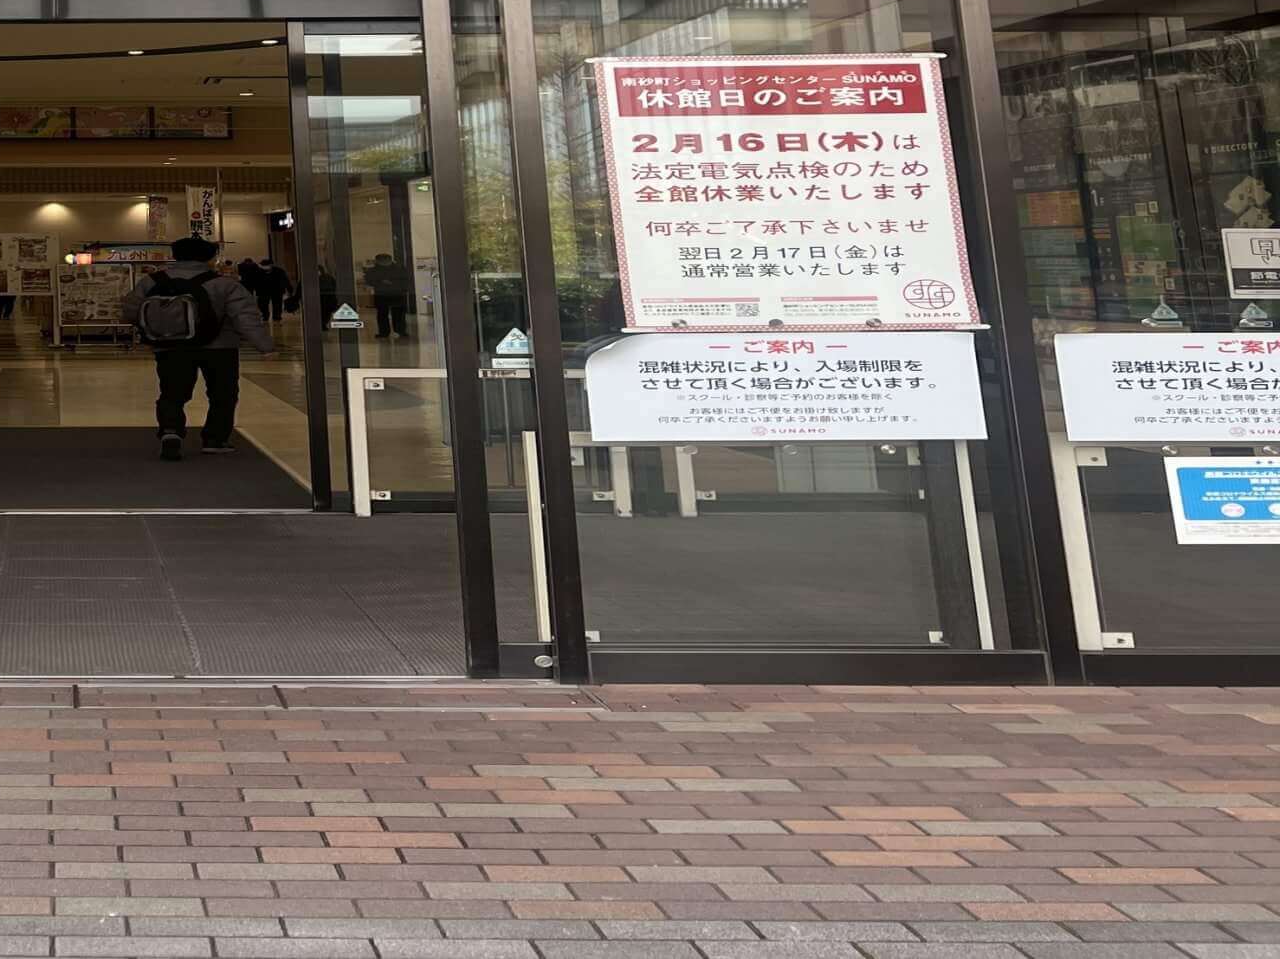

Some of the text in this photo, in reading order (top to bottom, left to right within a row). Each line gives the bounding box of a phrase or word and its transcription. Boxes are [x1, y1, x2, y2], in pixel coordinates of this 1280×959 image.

[841, 73, 917, 84] SUNAMO
[638, 87, 905, 109] 休館日のご案内
[631, 161, 930, 181] 法定電気点検のため
[635, 183, 931, 203] 全館休業いたします
[202, 190, 214, 237] がんばろう
[645, 219, 930, 237] 何卒ご了承下さいませ
[682, 263, 907, 279] 通常営業いたします
[638, 360, 923, 373] 混雑状況により、入場制限を
[1111, 360, 1279, 373] 混雑状況により、
[641, 377, 937, 390] させて頂く場合がございます。
